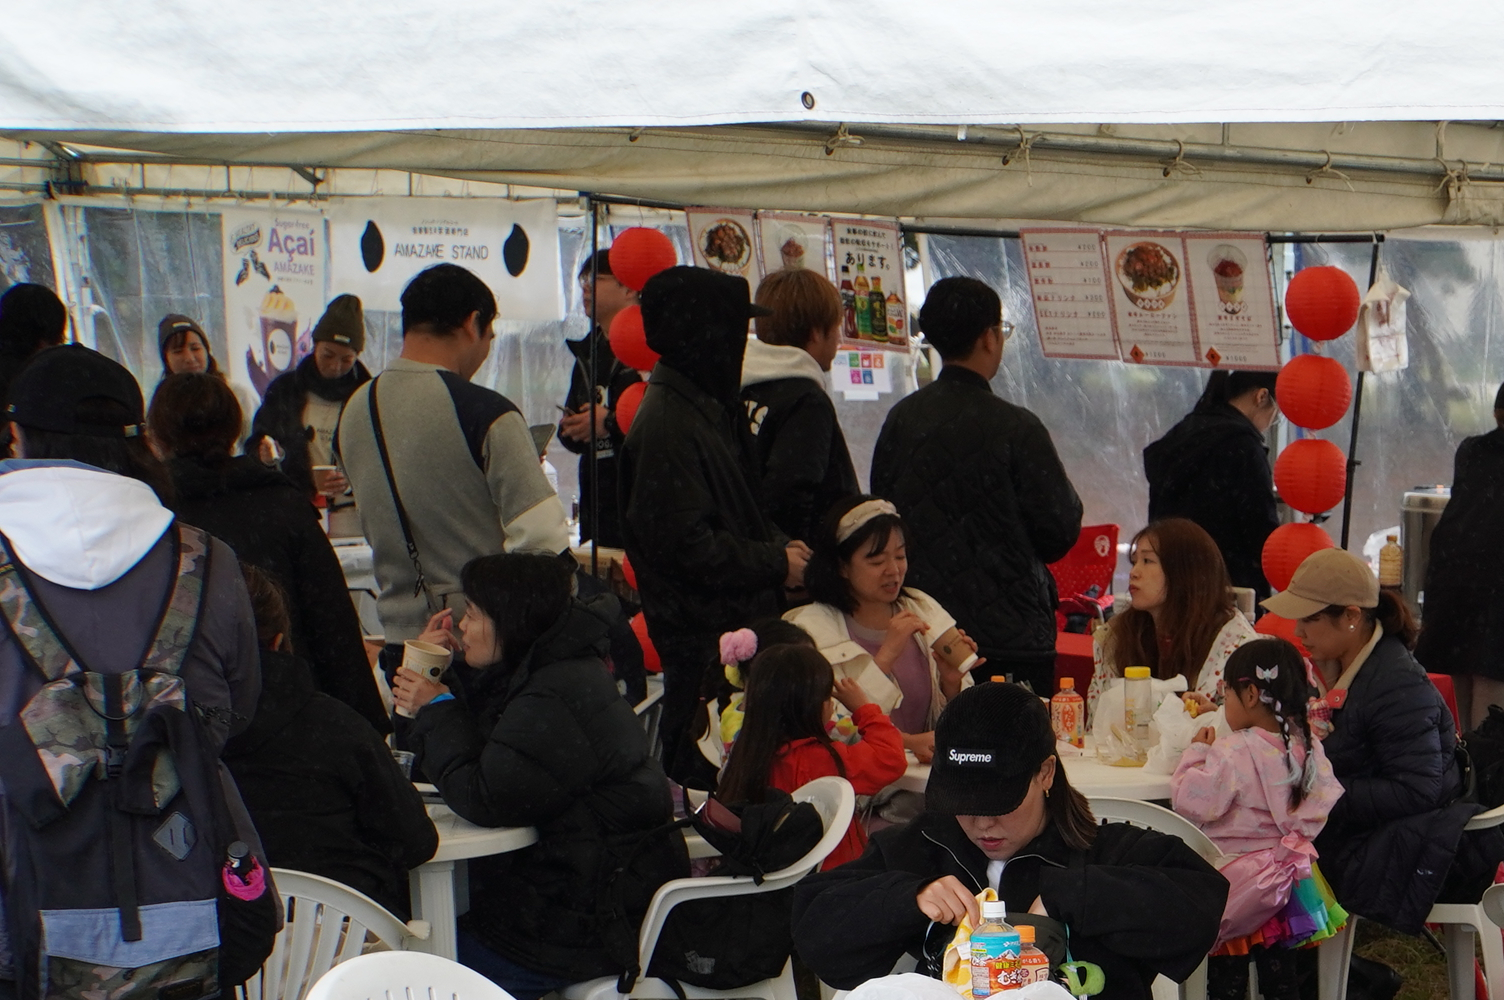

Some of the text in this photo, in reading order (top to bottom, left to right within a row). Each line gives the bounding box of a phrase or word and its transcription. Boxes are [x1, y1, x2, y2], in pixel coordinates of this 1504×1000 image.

[268, 227, 315, 262] Açaí
[394, 243, 489, 260] AMAZAKE STAND
[274, 262, 315, 276] AMAZAKE
[949, 749, 991, 764] Supreme
